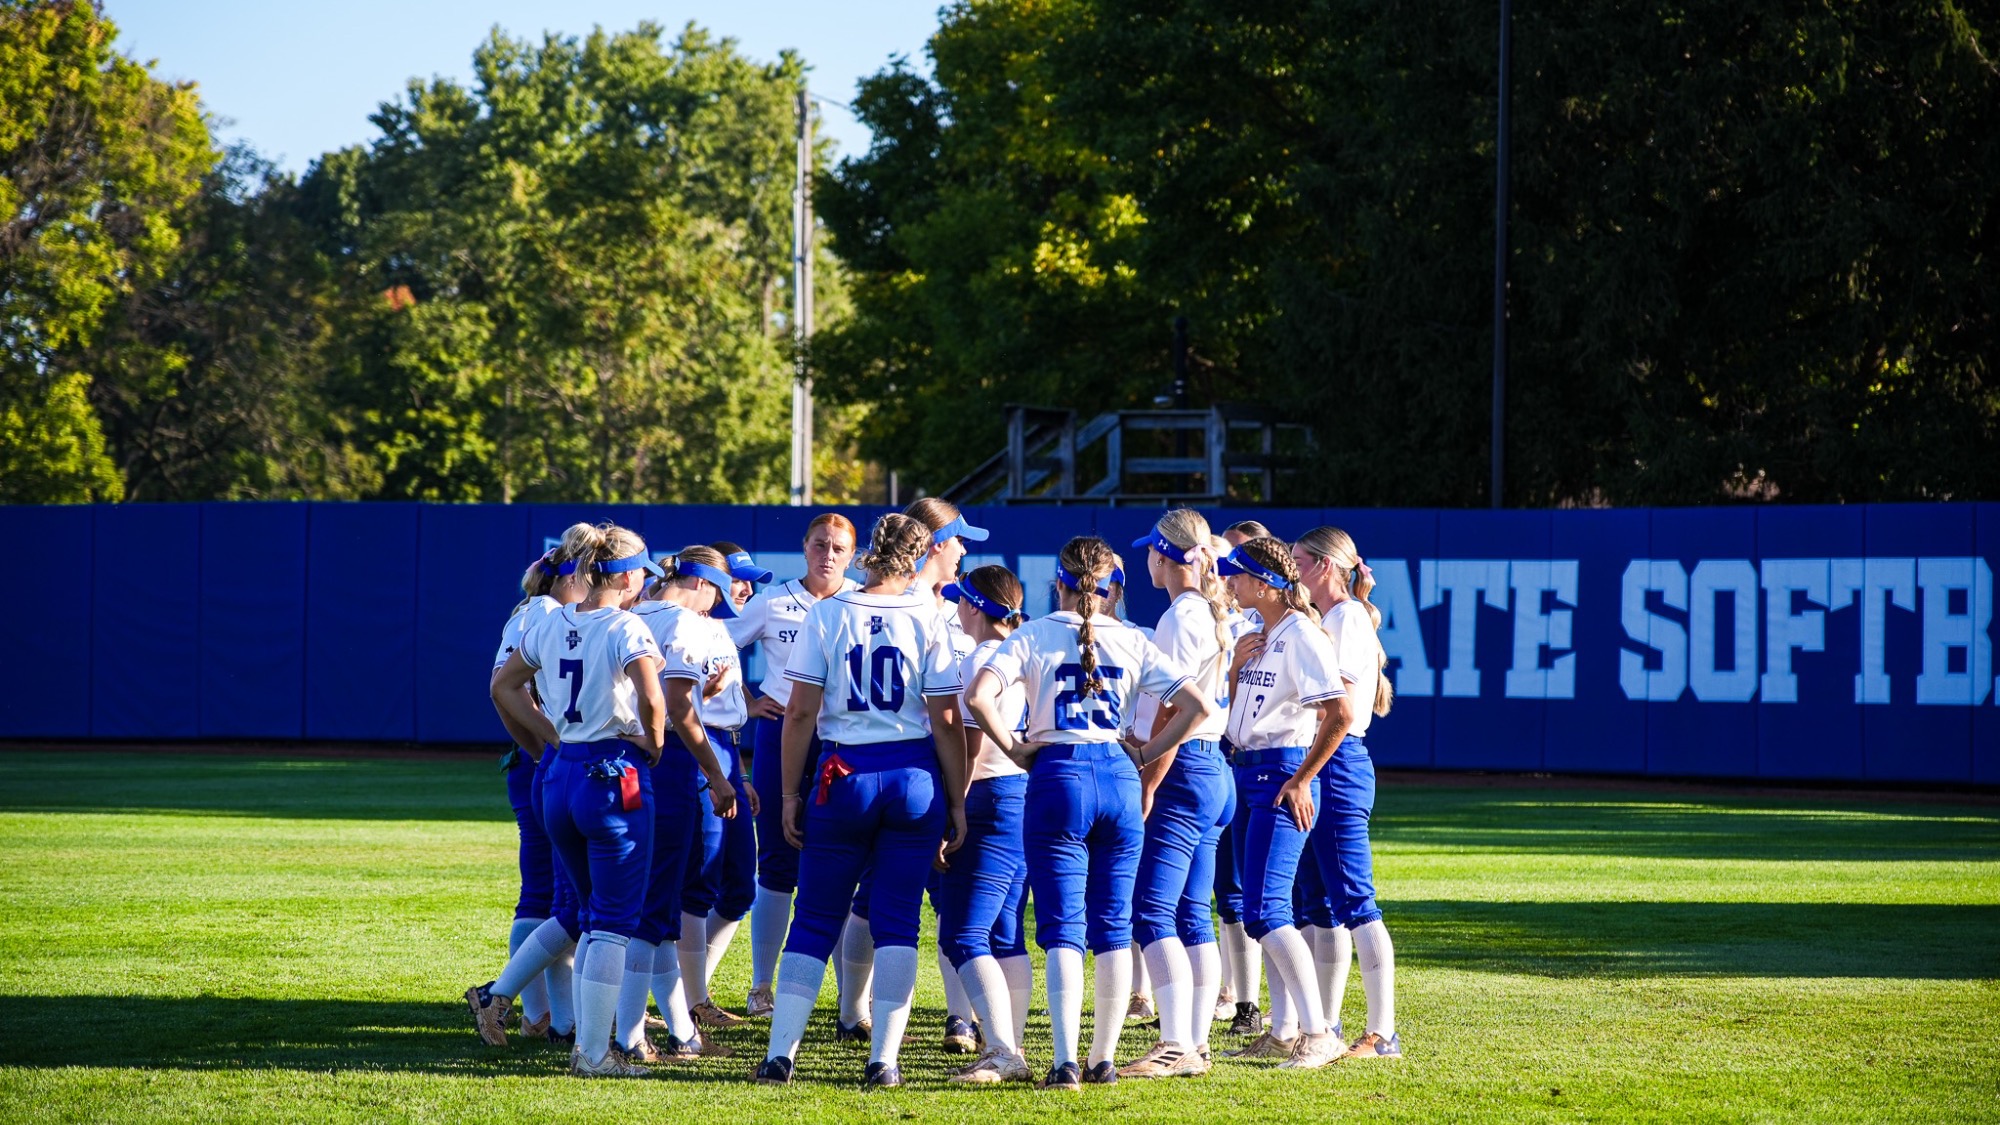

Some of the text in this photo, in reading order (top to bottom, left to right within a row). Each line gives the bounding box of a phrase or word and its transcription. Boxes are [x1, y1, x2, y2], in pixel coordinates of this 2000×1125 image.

[1347, 556, 2000, 706] ATE SOFTB
[559, 658, 583, 724] 7
[845, 644, 905, 713] 10
[1055, 663, 1124, 730] 25
[1253, 694, 1265, 718] 3
[678, 1045, 692, 1053] UA
